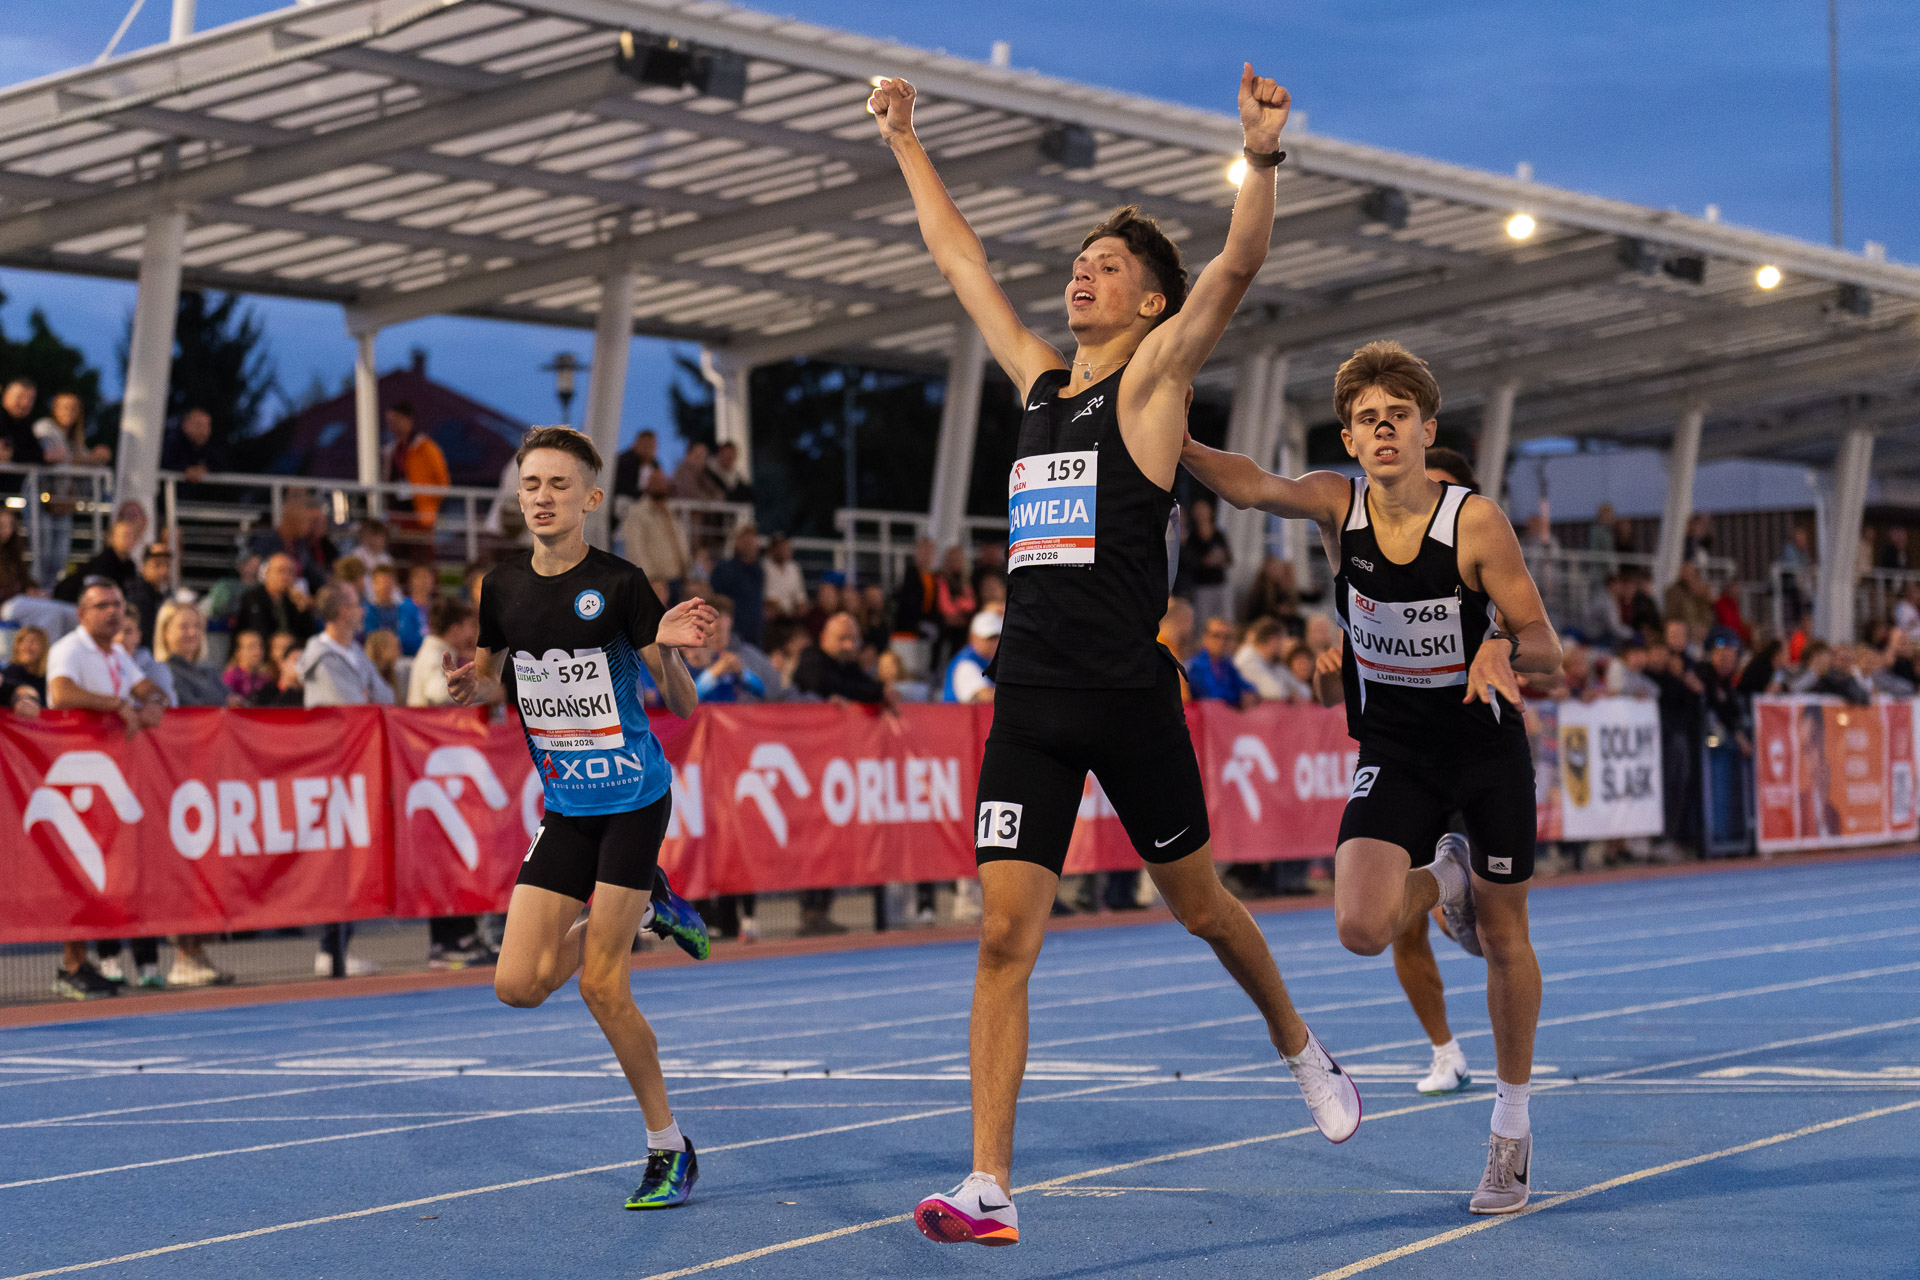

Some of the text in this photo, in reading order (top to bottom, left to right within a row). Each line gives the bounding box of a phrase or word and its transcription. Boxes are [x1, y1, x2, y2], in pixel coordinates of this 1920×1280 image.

[1047, 458, 1086, 482] 159
[1014, 553, 1034, 564] LUBIN
[1036, 551, 1059, 561] 2026
[1403, 604, 1449, 625] 968
[1353, 624, 1457, 658] SUWALSKI
[558, 661, 600, 684] 592
[1377, 673, 1432, 685] LUBIN 2026
[520, 693, 612, 718] BUGAŃSKI
[550, 739, 595, 748] LUBIN 2026
[1294, 751, 1360, 800] ORLE
[821, 756, 962, 827] ORLEN
[169, 773, 371, 860] ORLEN
[980, 808, 1018, 840] 13
